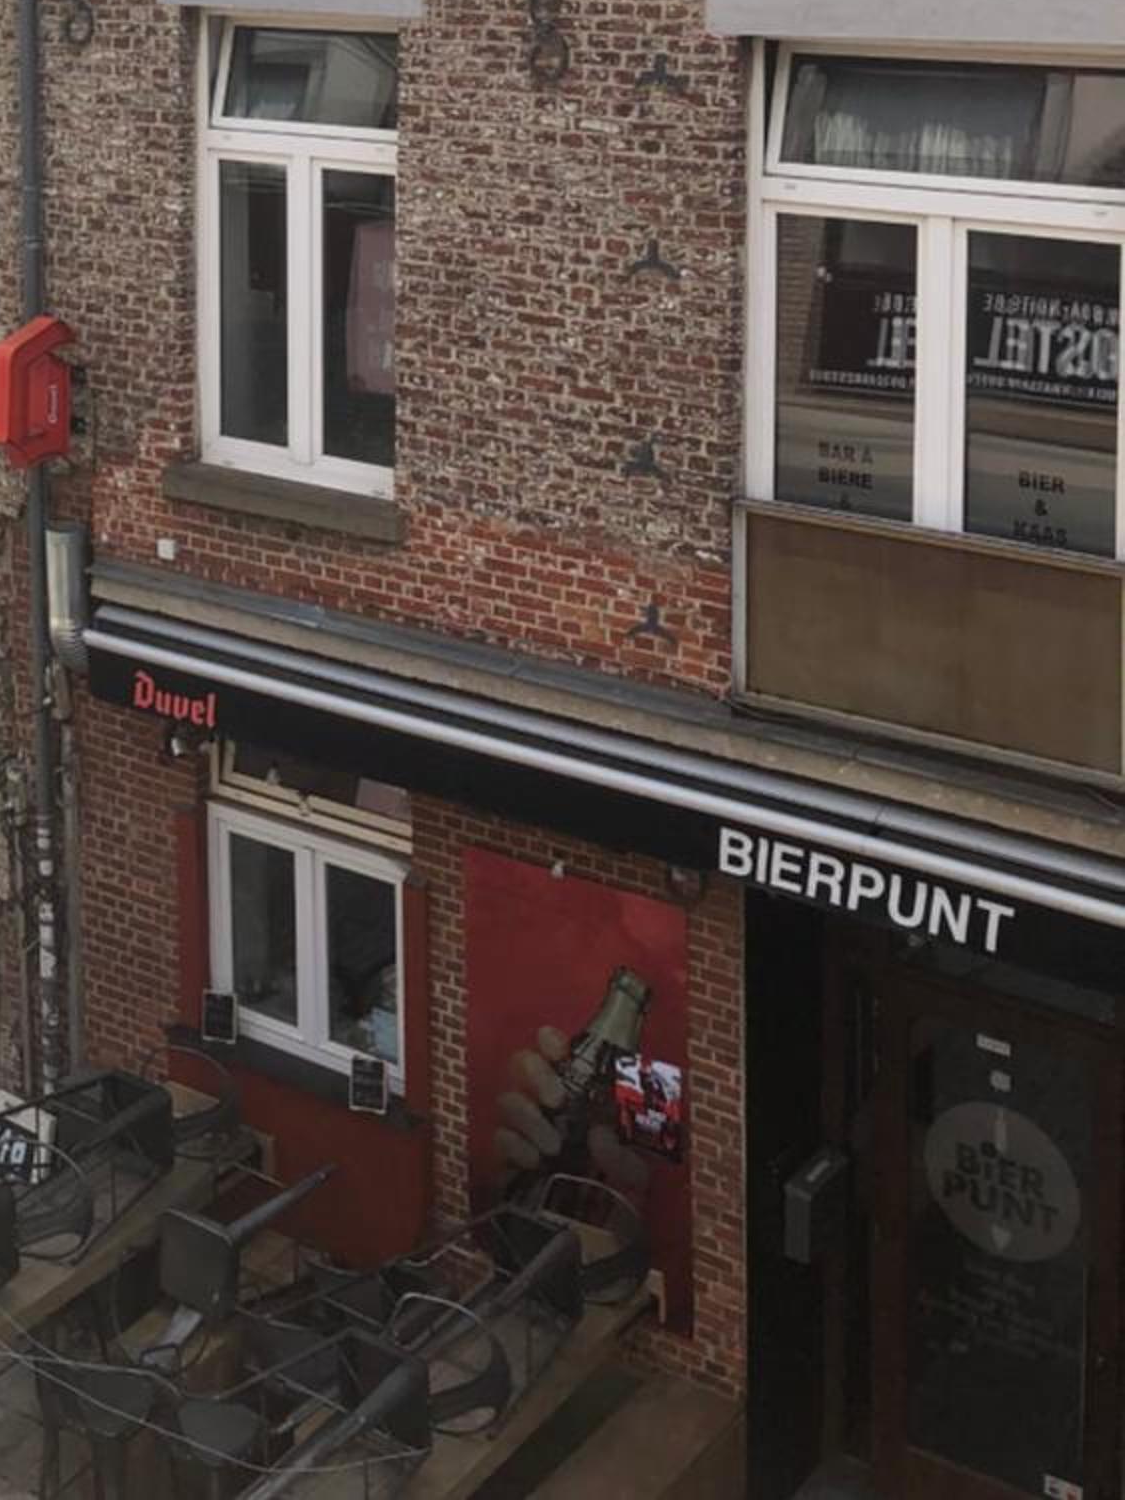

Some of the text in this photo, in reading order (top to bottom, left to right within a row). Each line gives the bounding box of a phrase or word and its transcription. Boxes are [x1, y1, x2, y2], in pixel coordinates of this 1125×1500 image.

[1018, 470, 1065, 494] BIER
[134, 669, 217, 729] Duvel
[718, 826, 1016, 953] BIERPUNT
[955, 1141, 1045, 1199] BIER
[942, 1170, 1060, 1235] PUNT
